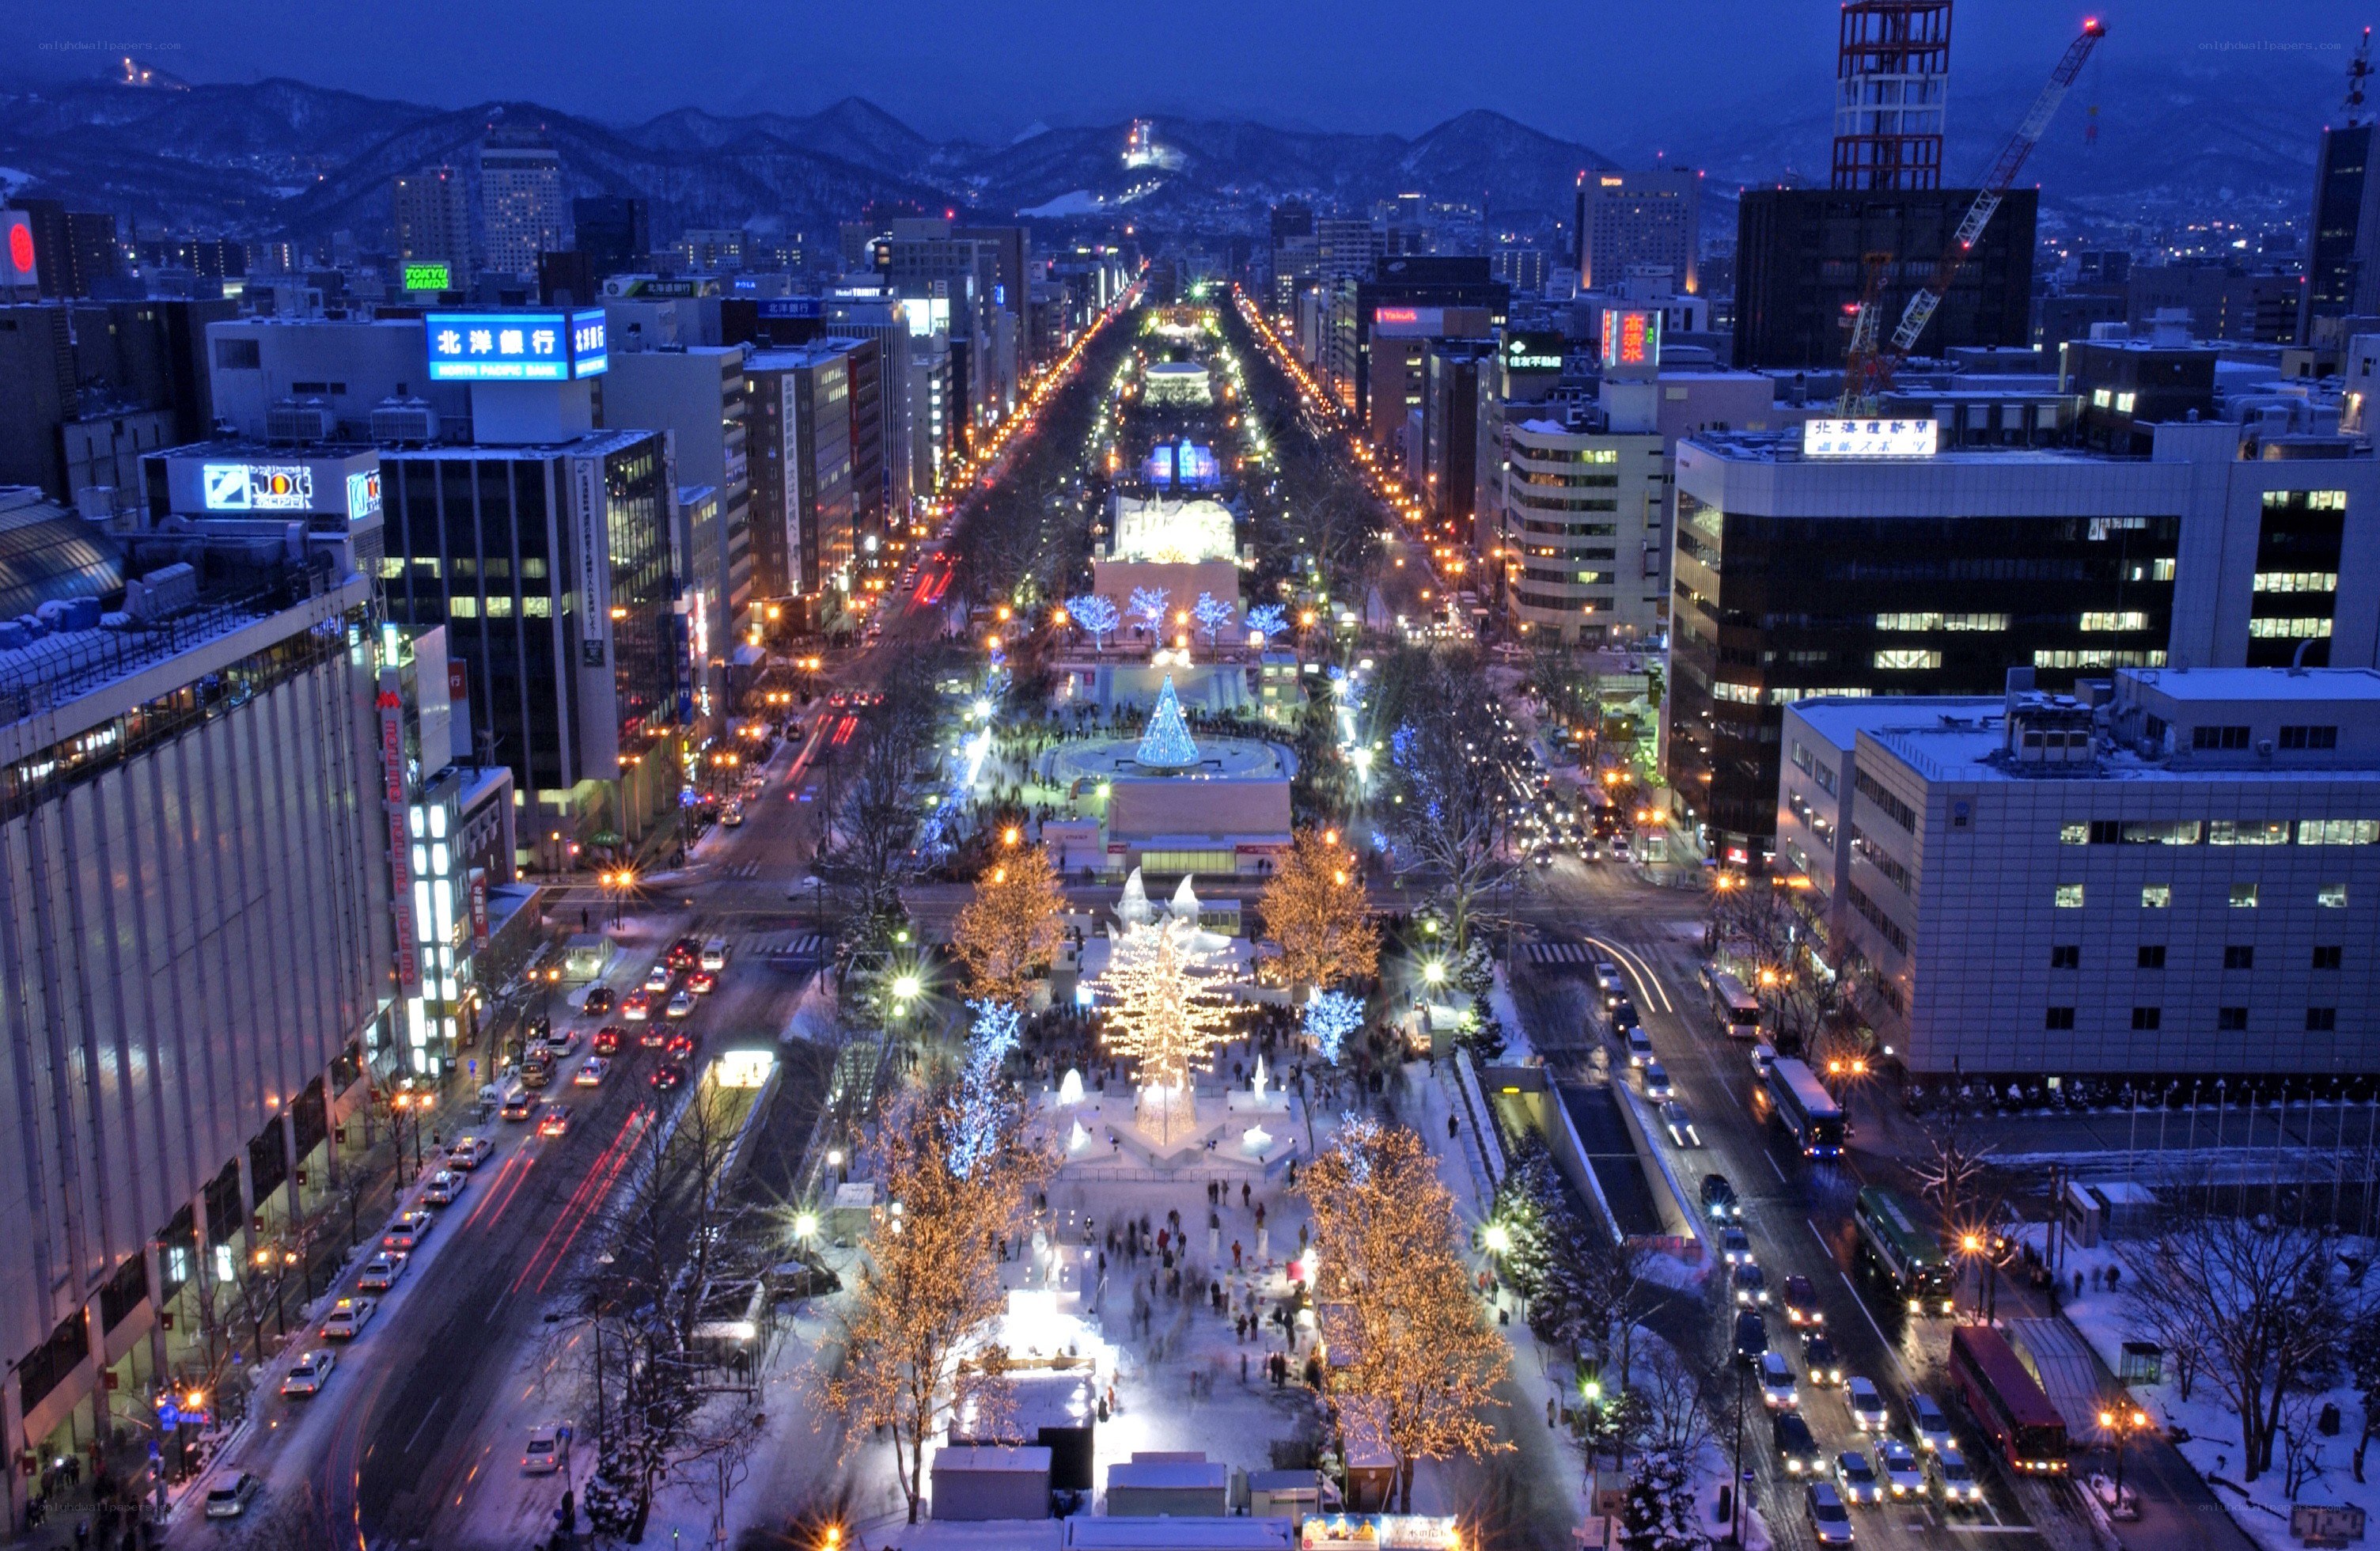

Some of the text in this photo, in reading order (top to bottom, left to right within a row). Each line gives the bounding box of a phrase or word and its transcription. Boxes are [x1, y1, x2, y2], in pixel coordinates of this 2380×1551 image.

[405, 268, 448, 279] TOKYU
[407, 279, 449, 290] HANDS
[852, 287, 880, 297] TRINITY
[768, 303, 809, 313] 北洋銀行
[1384, 310, 1416, 321] Yakult
[438, 329, 555, 355] 北洋銀行
[1509, 355, 1562, 368] 住友不動産
[439, 365, 557, 376] NORTH PACIFIC BANK
[1815, 421, 1927, 434] 北海道新聞
